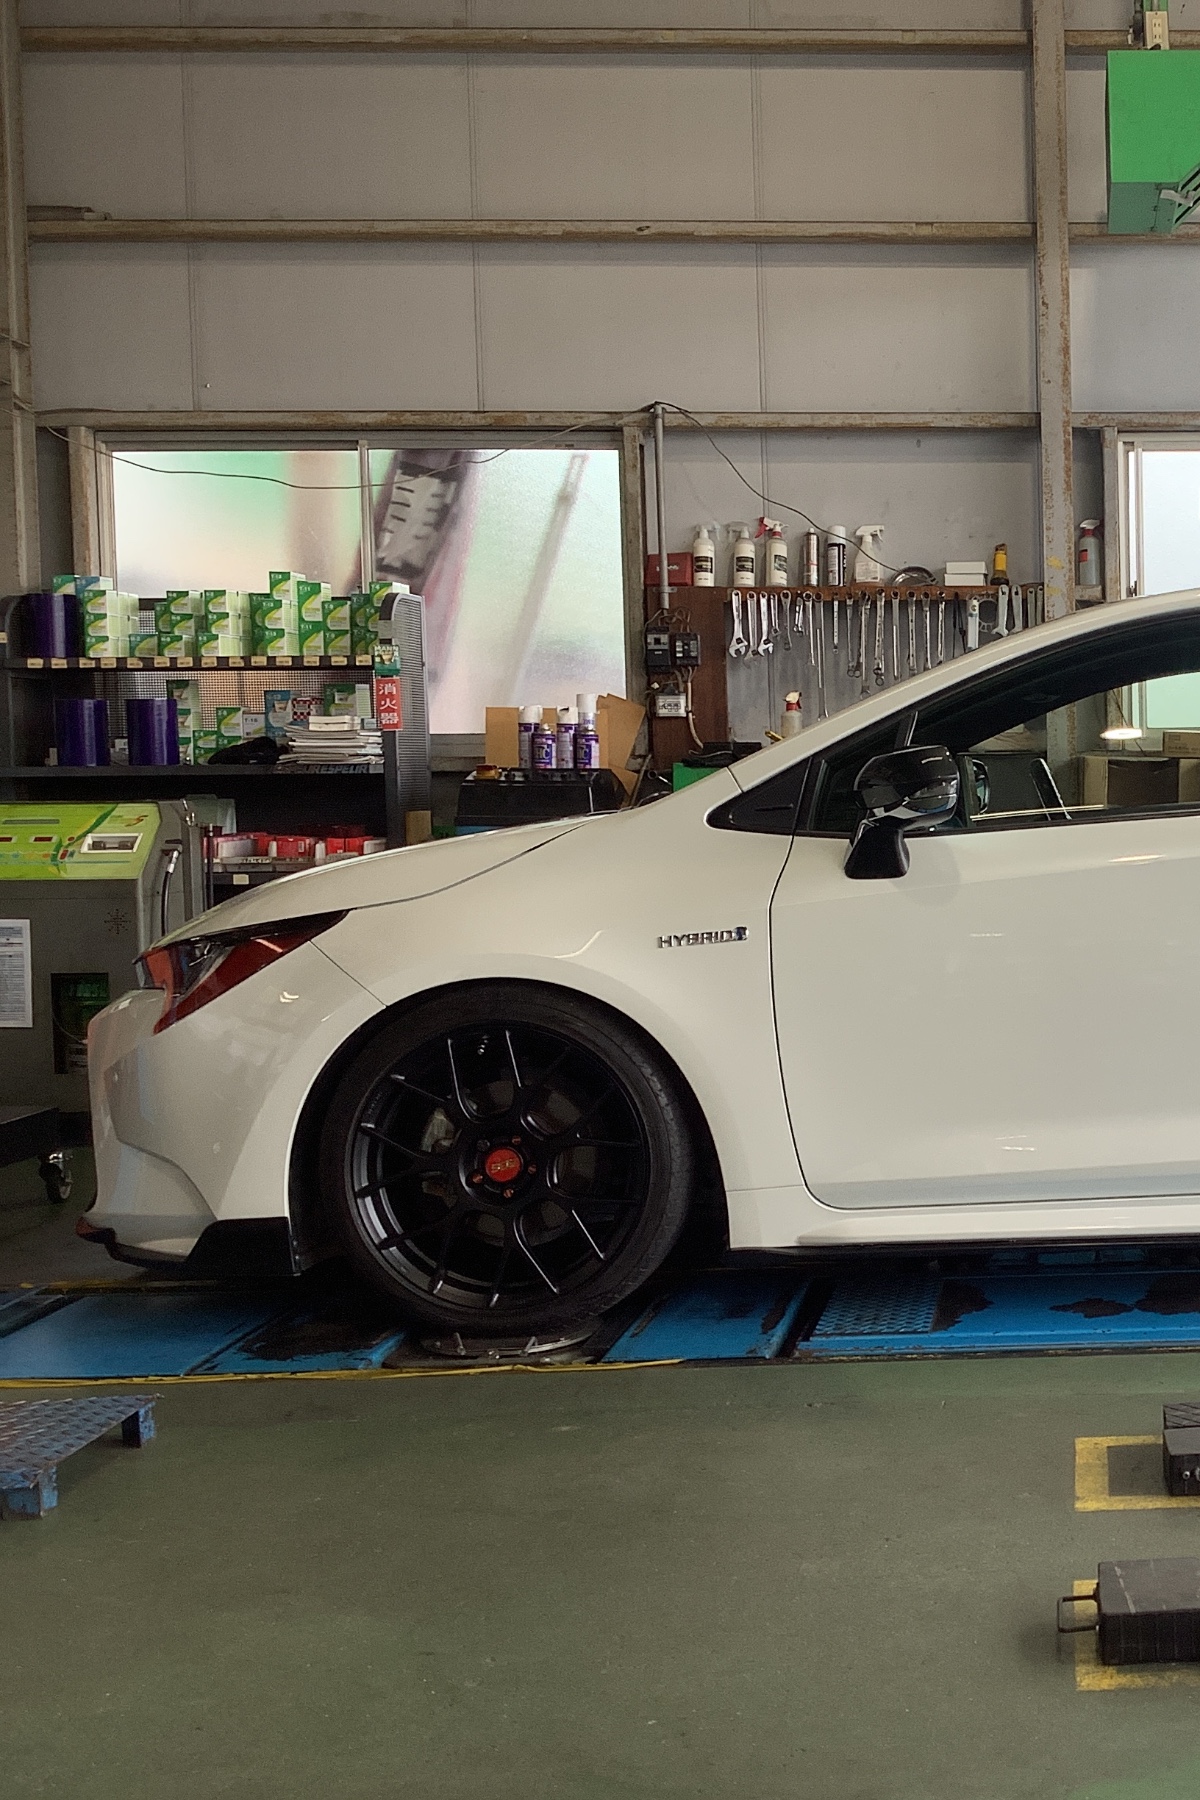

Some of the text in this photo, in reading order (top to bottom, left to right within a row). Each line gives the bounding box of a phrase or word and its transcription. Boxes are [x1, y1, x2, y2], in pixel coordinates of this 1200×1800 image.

[379, 682, 400, 725] 消火器
[657, 929, 735, 949] HYBRID
